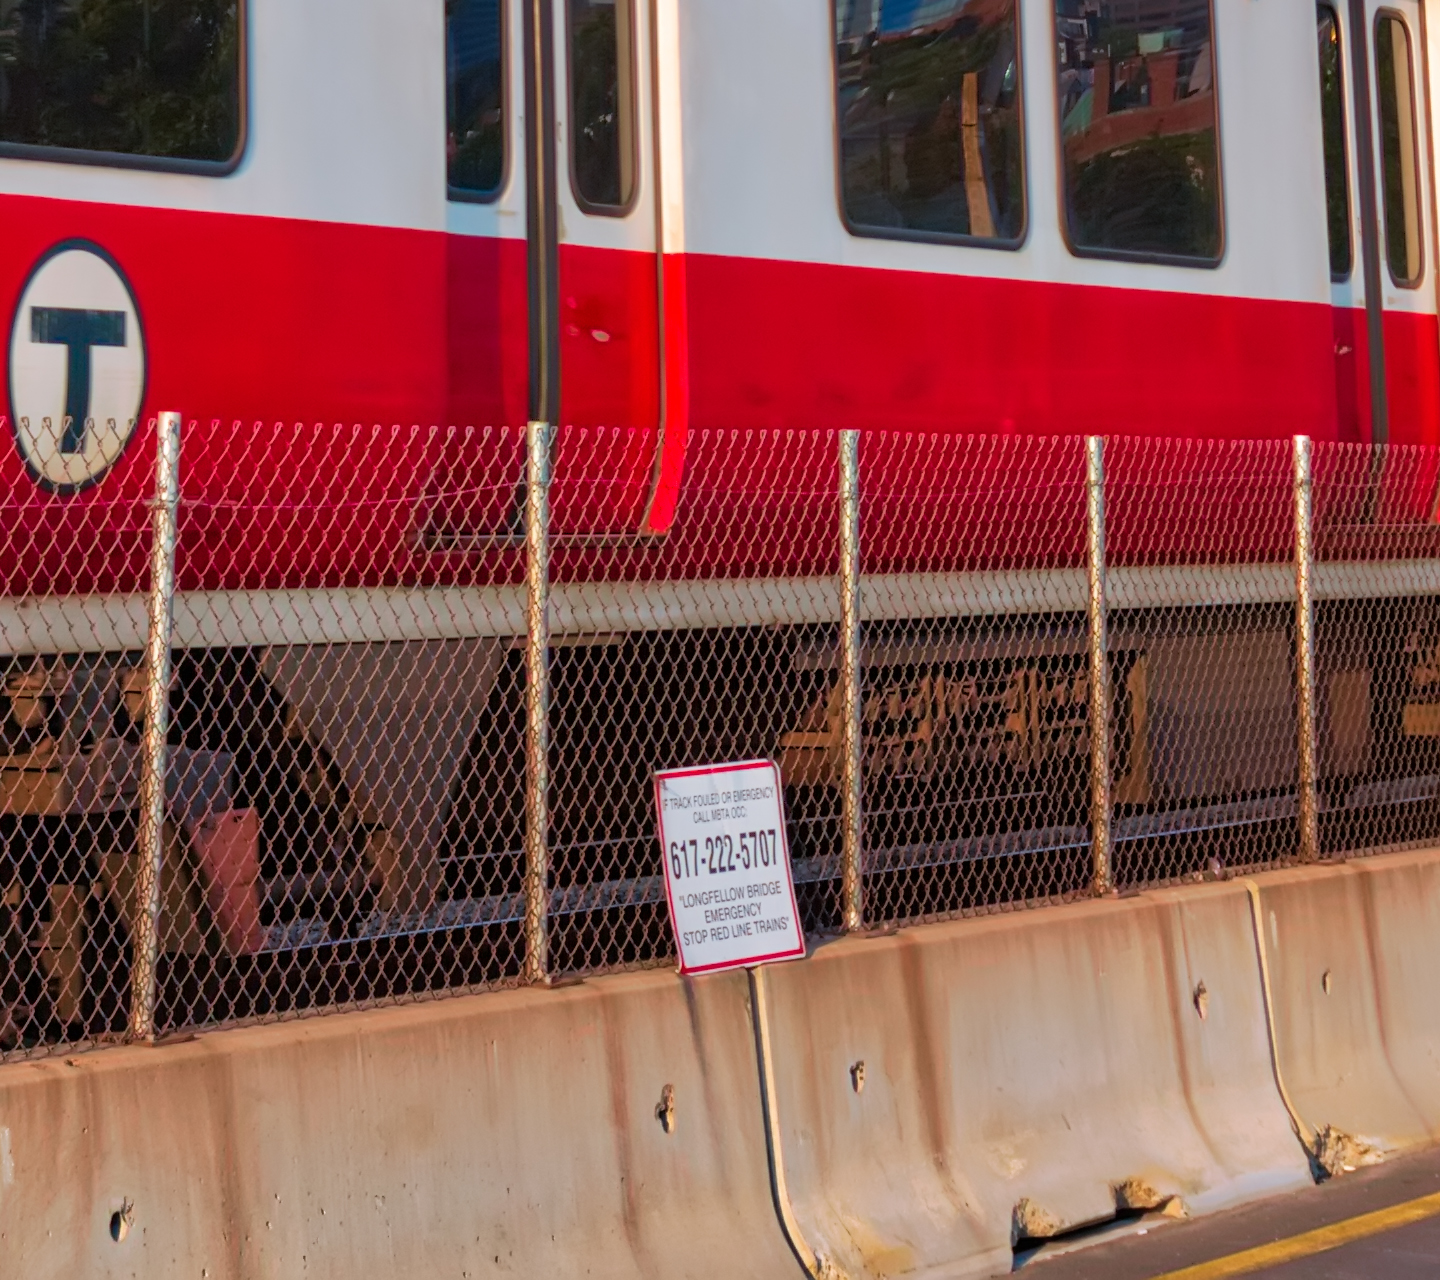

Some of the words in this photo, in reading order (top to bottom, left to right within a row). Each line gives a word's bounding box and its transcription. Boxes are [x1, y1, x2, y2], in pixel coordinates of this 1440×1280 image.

[30, 305, 128, 454] T
[669, 796, 693, 810] TRACK
[693, 792, 720, 807] FOULED
[721, 791, 732, 804] OR
[732, 786, 774, 803] EMERGENCY
[693, 811, 711, 824] CALL
[711, 807, 730, 821] MBTA
[670, 829, 776, 880] 617-222-5707
[679, 886, 745, 908] "LONGFELLOW
[746, 881, 782, 899] BRIDGE
[704, 902, 762, 924] EMERGENCY
[683, 929, 708, 946] STOP
[710, 926, 730, 942] RED
[731, 922, 753, 938] LINE
[753, 916, 789, 934] TRAINS"
